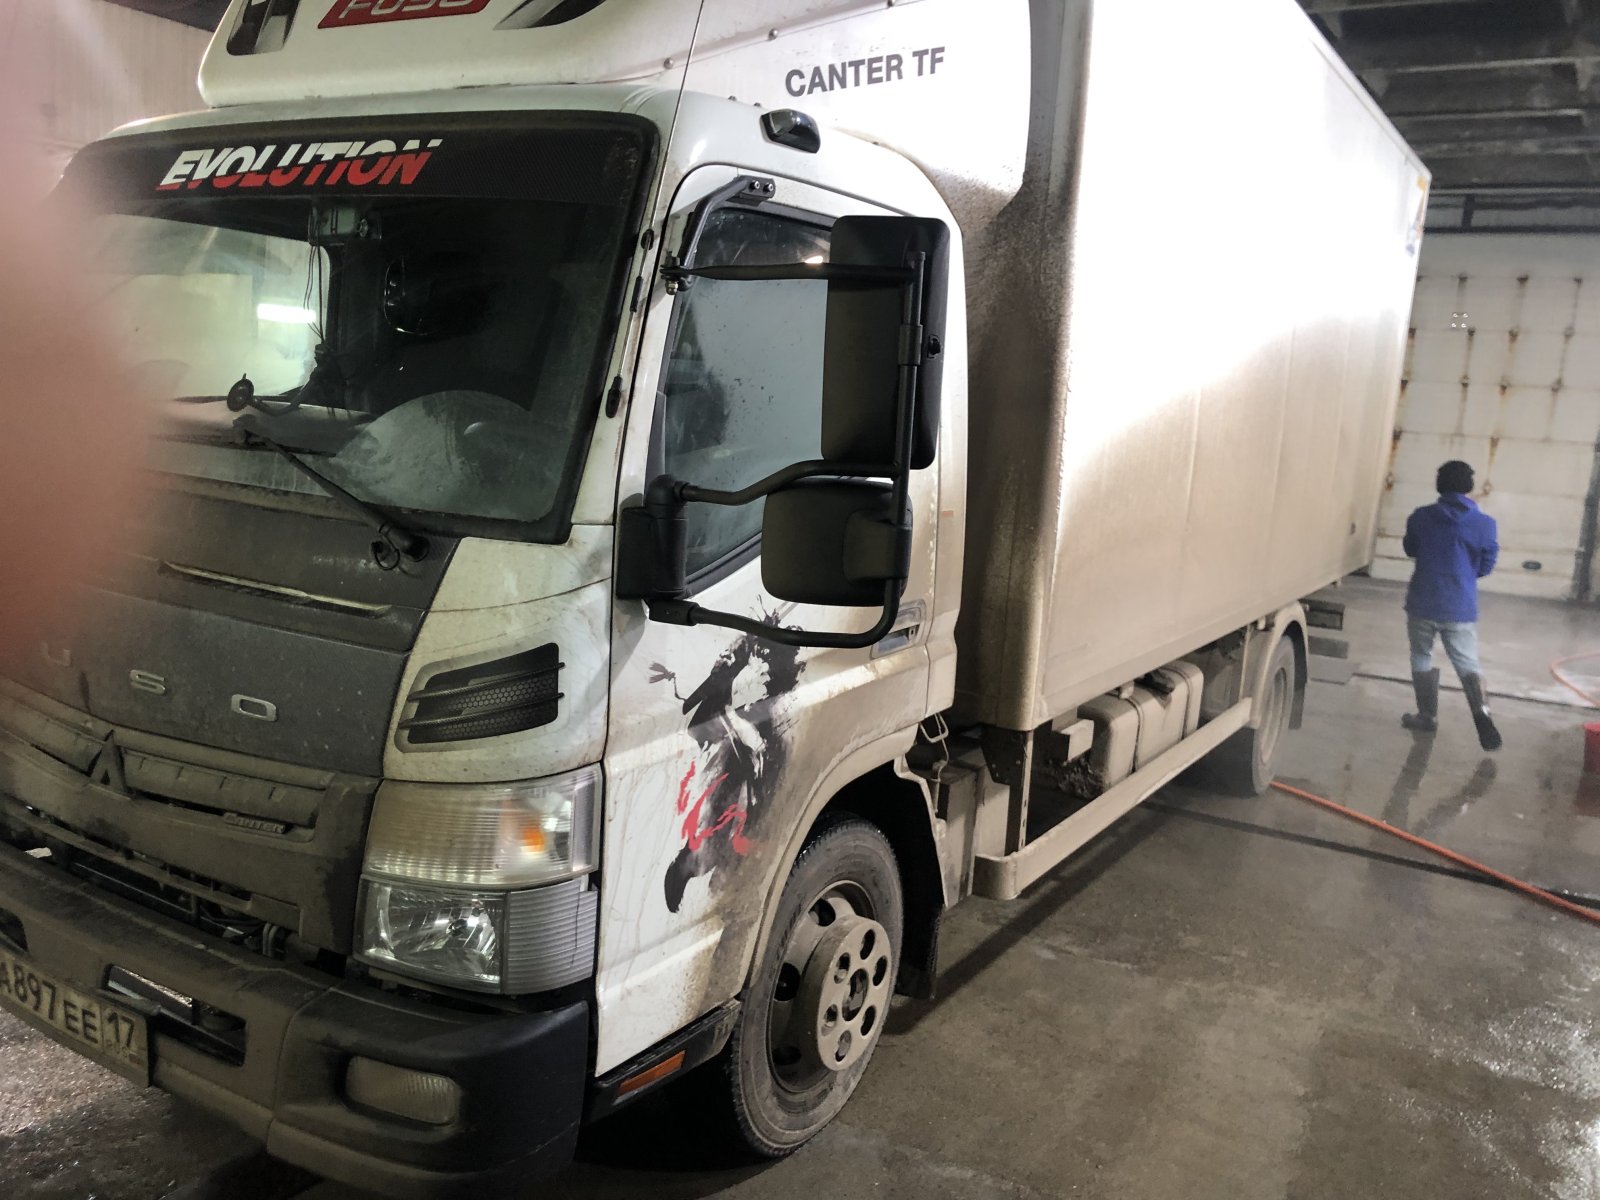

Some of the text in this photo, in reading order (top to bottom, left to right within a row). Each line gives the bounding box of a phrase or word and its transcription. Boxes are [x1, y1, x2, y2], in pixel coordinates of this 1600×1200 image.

[785, 46, 945, 98] CANTER TF
[156, 138, 444, 191] EVOLUTION
